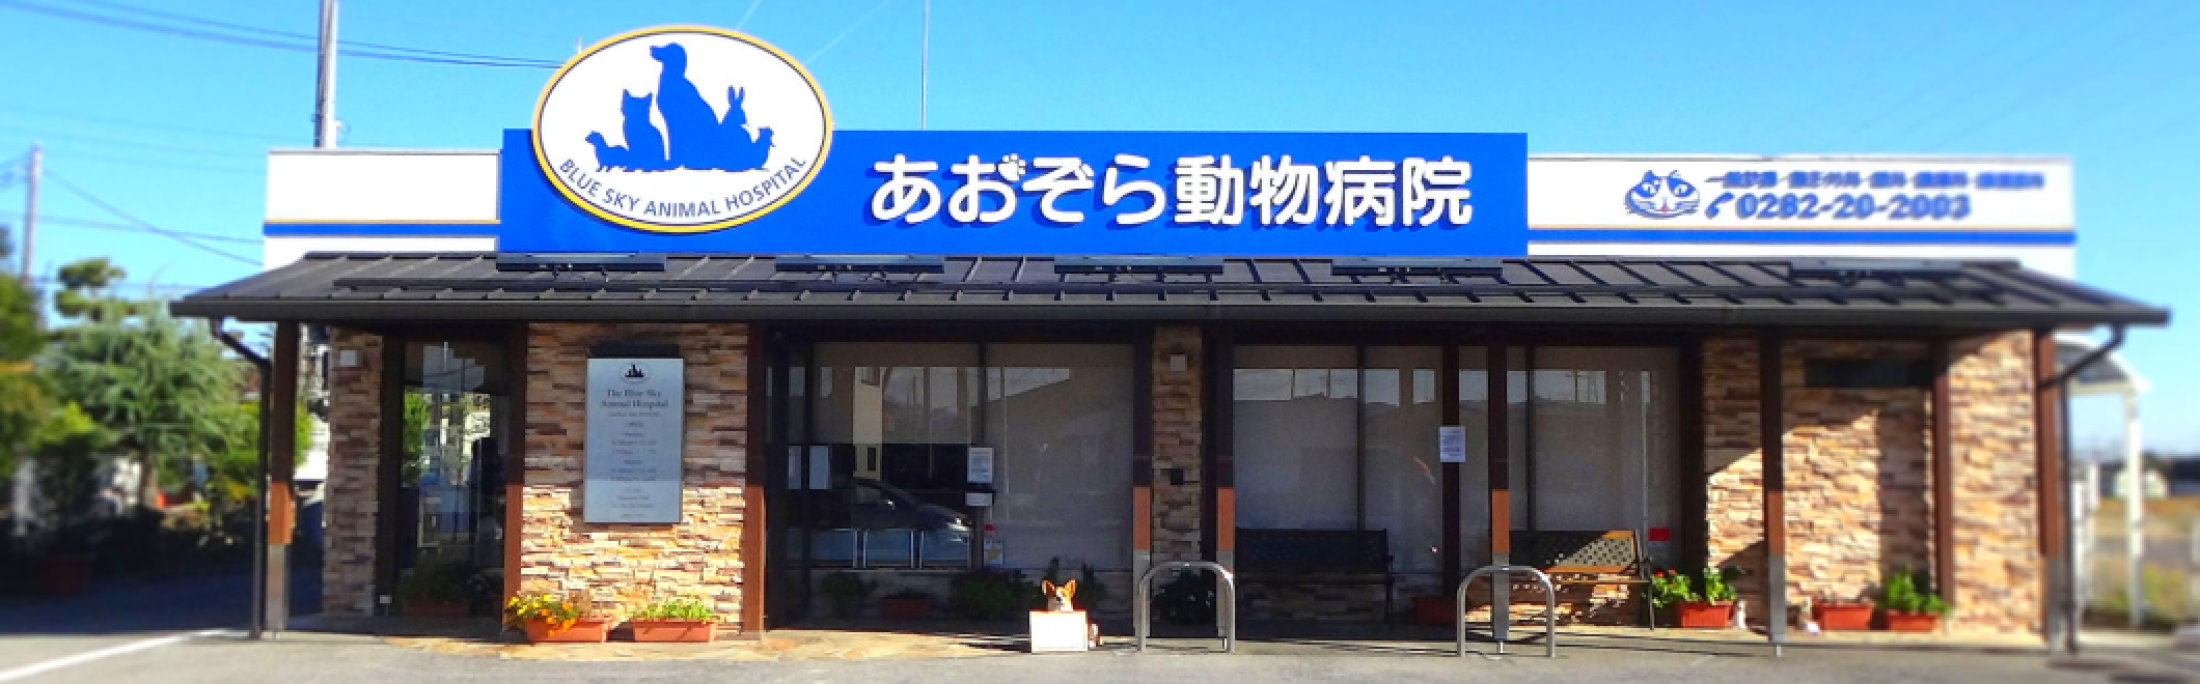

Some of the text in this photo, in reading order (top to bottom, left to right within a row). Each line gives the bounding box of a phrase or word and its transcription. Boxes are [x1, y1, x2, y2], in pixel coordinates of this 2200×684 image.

[559, 157, 807, 218] BLUE SKY ANIMAL HOSPITAL
[871, 153, 1473, 226] あおぞら動物病院
[1735, 192, 1973, 220] 0282-20-2003
